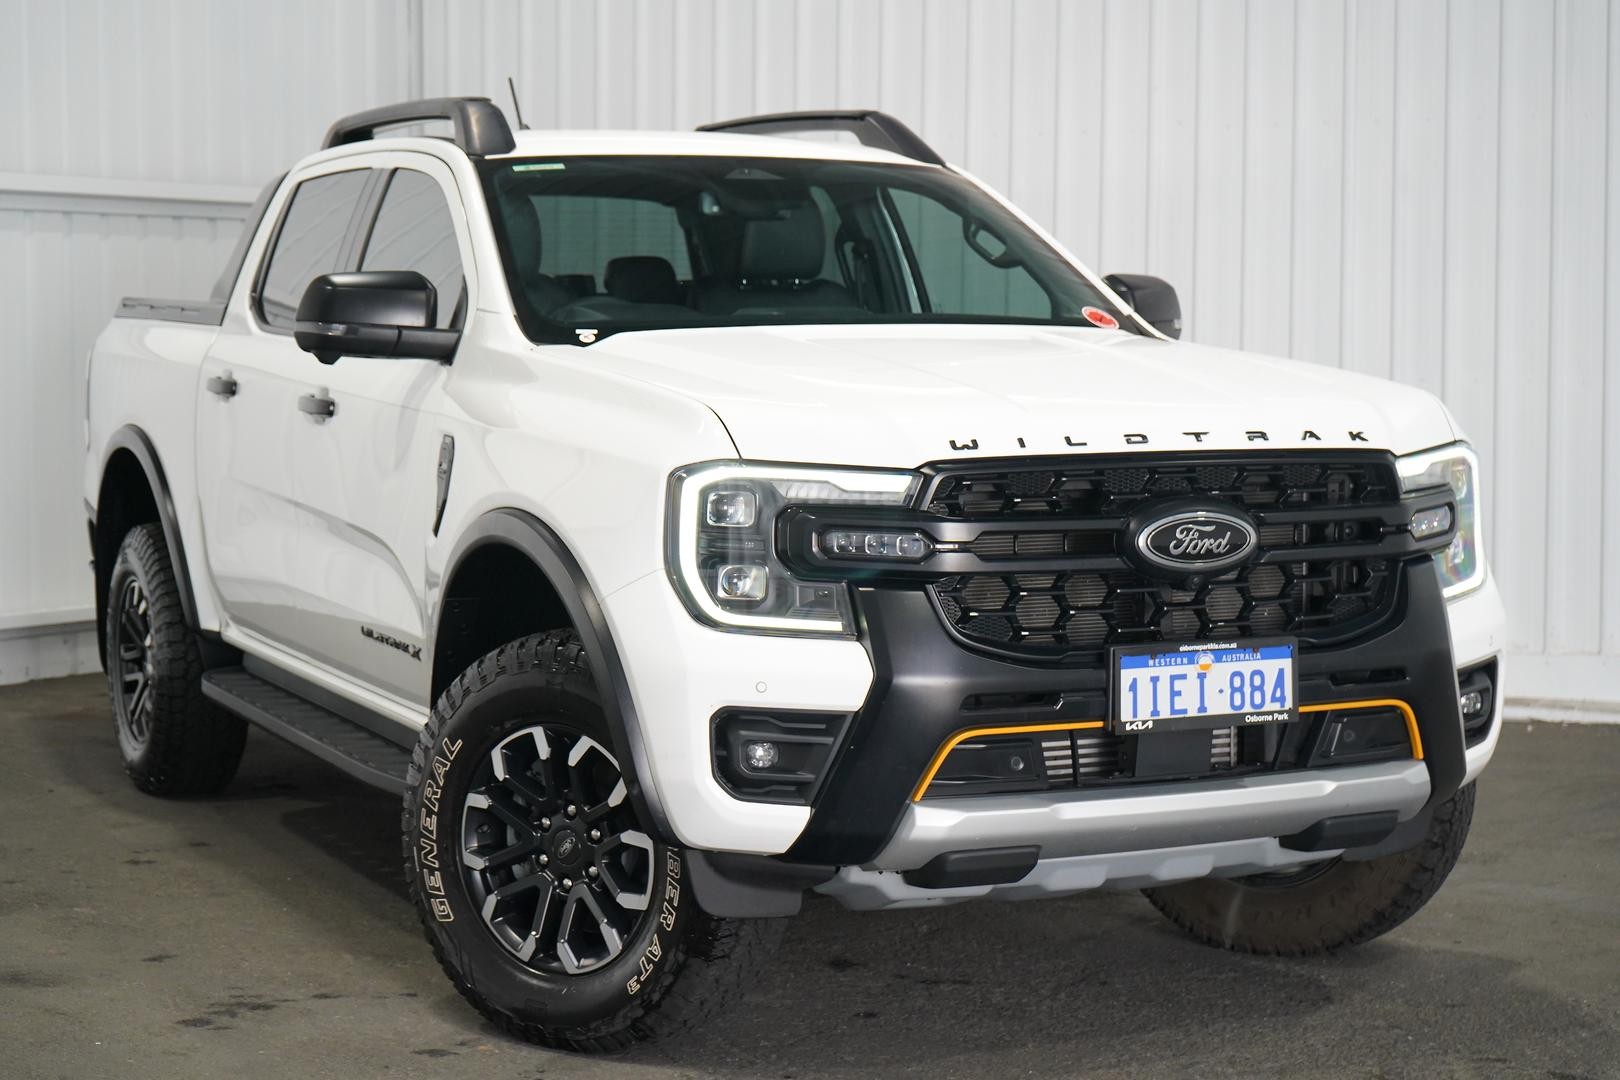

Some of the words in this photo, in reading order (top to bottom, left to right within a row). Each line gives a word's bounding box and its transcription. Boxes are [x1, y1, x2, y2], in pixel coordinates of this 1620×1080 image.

[949, 430, 1369, 451] WILDTRAK
[1169, 524, 1231, 556] Ford
[1148, 656, 1188, 667] WESTERN
[1222, 652, 1262, 662] AUSTRALIA
[1245, 713, 1273, 723] Osborne
[1274, 711, 1289, 721] Park
[420, 737, 463, 922] GENERAL
